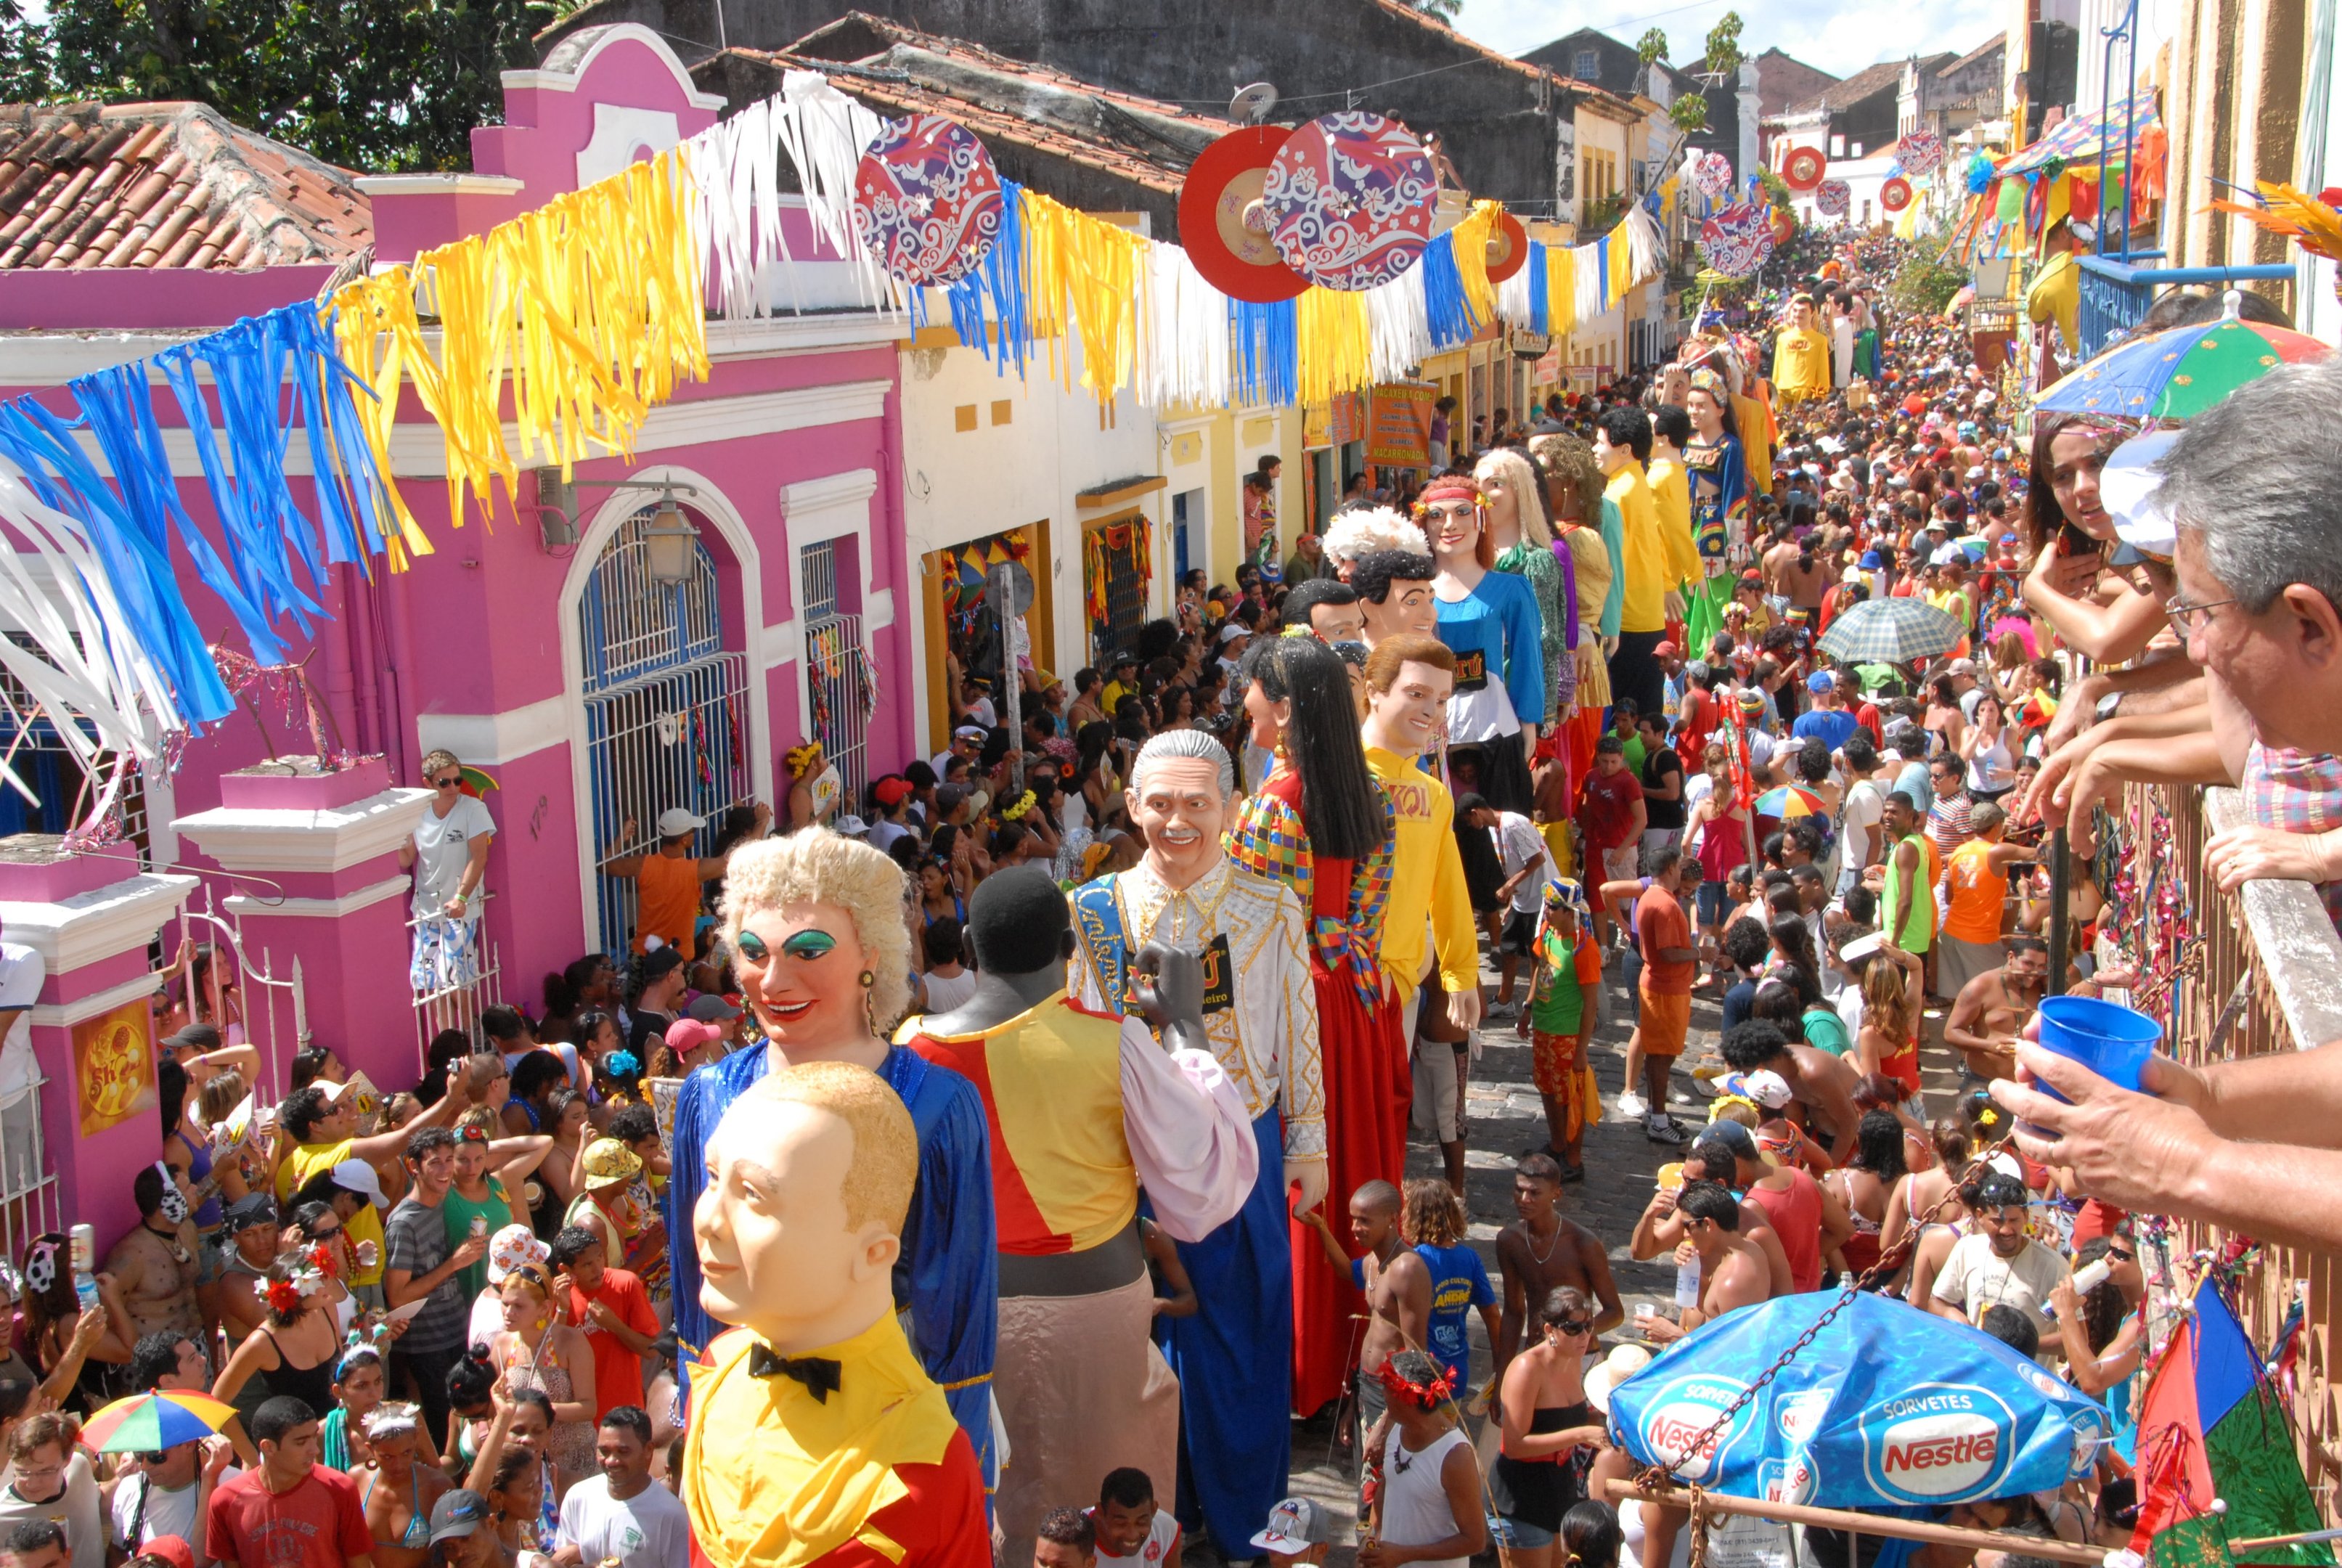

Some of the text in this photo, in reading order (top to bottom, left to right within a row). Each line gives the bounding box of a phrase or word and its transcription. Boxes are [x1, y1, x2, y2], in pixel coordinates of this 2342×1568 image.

[1374, 447, 1425, 460] MACARRONADA
[1455, 653, 1482, 678] TÚ
[1388, 781, 1432, 819] KOL
[1883, 1395, 1973, 1420] SORVETES
[1885, 1430, 1996, 1473] Nestlé
